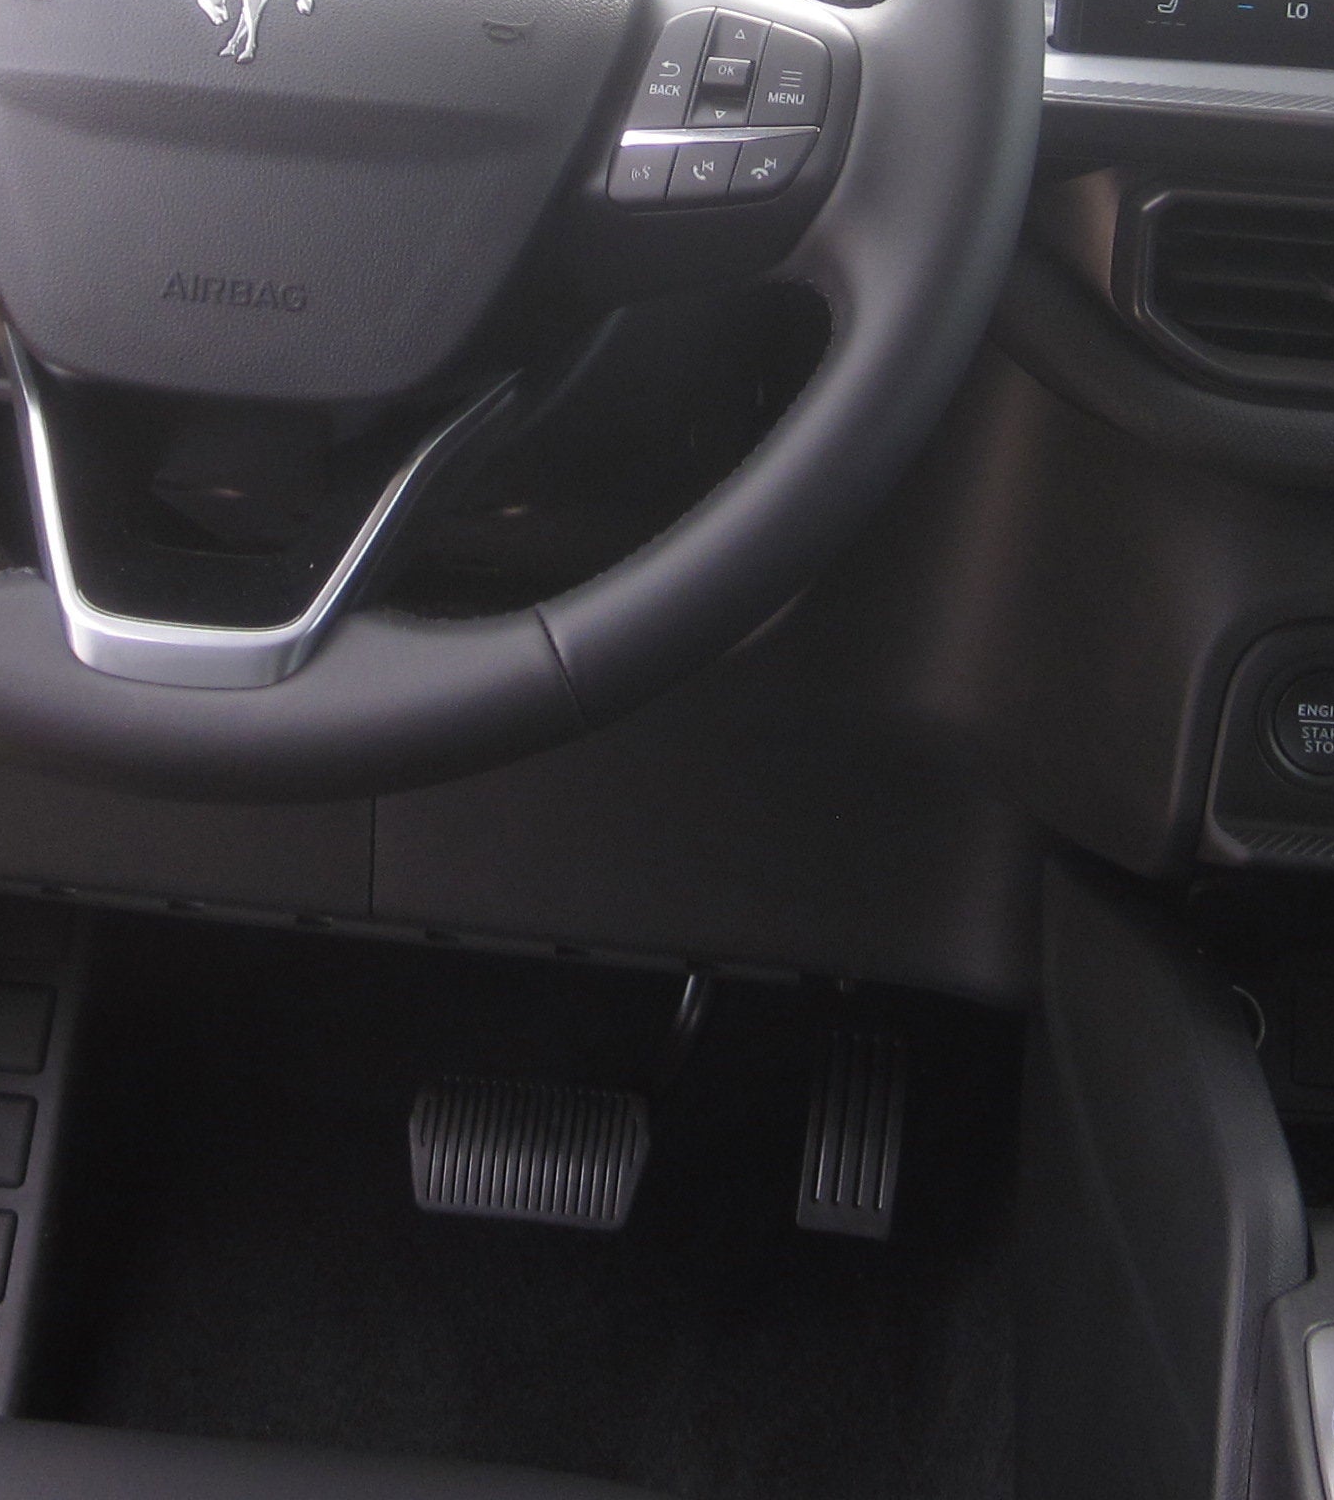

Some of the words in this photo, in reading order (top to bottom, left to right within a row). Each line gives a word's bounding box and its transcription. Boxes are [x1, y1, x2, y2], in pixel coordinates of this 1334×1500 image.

[1287, 2, 1309, 19] LO
[718, 63, 735, 77] OK
[649, 83, 682, 97] BACK
[767, 91, 806, 106] MENU
[163, 270, 309, 313] AIRBAG
